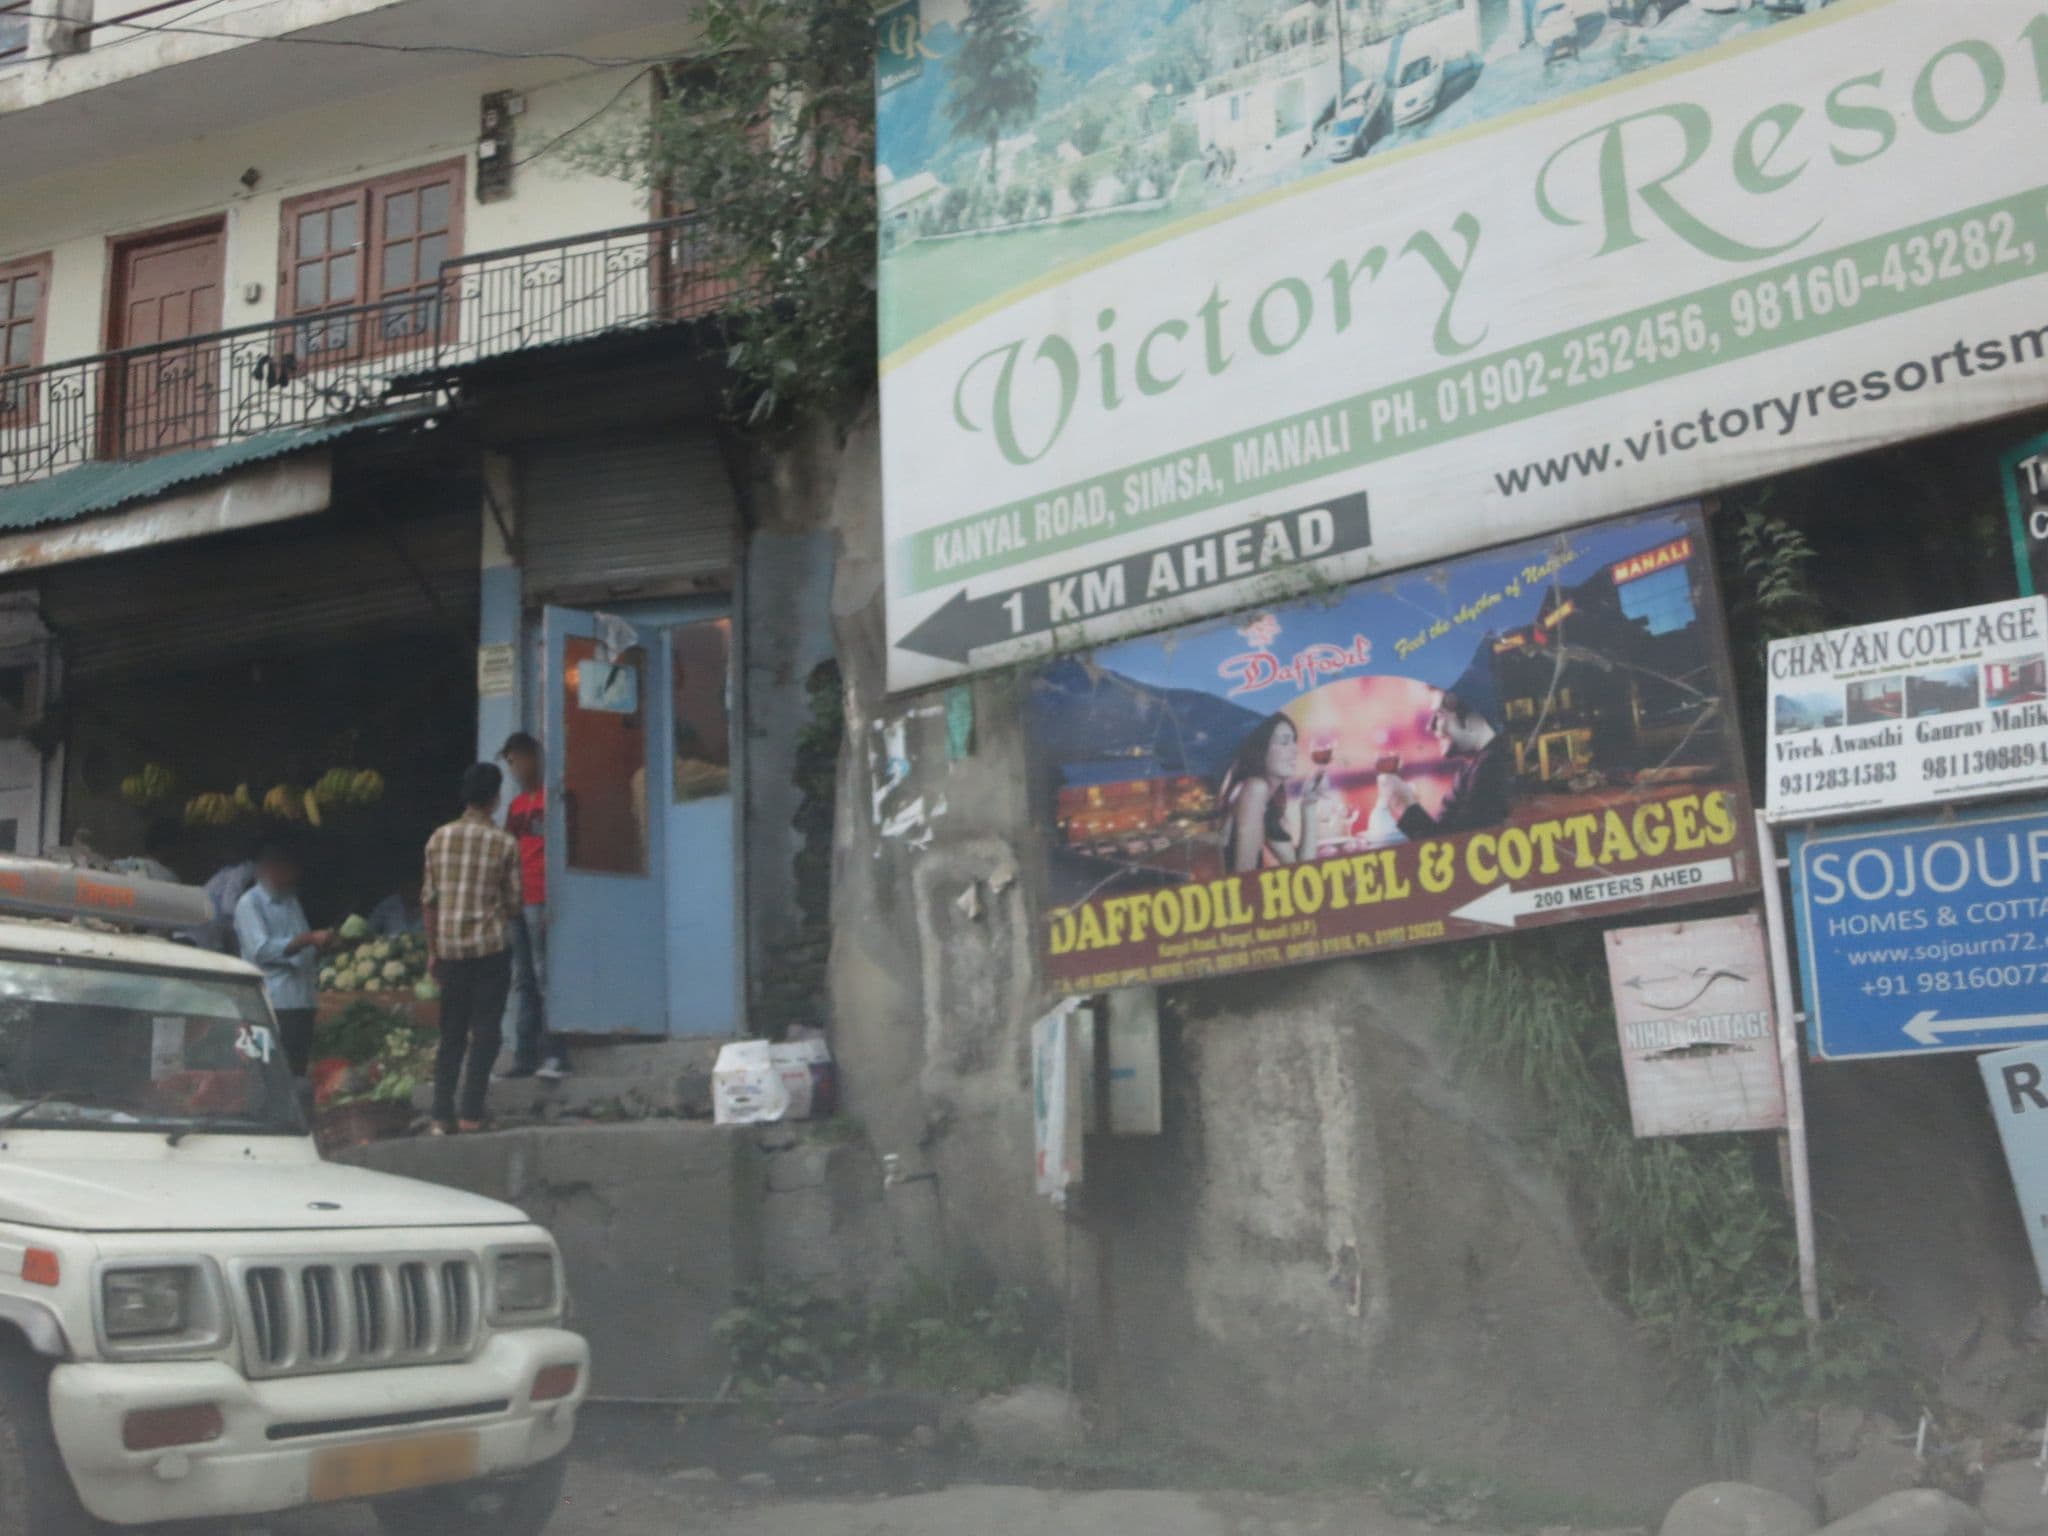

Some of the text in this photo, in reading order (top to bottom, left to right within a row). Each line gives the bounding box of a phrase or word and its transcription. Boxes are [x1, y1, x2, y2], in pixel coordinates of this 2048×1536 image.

[953, 211, 1489, 465] Victory
[933, 211, 2034, 571] KANYAL ROAD, SIMSA, MANALI PH. 01902-252456, 98160-43282,
[1002, 509, 1335, 633] 1 KM AHEAD
[1615, 541, 1690, 580] MANALI
[1771, 632, 1889, 680] CHAYAN
[1898, 608, 2038, 659] COTTAGE
[1776, 725, 1903, 762] Vivek Awasthi
[1916, 721, 1984, 743] Gaurav
[1051, 877, 1254, 955] DAFFODIL
[1260, 850, 1411, 920] HOTEL
[1418, 842, 1454, 893] &
[1466, 791, 1736, 885] COTTAGES
[1534, 868, 1702, 908] 200 METERS AHED
[1829, 908, 1928, 936] HOMES
[1937, 905, 1959, 927] &
[1848, 932, 2048, 965] www.sojourn72.
[1861, 975, 1909, 996] +91
